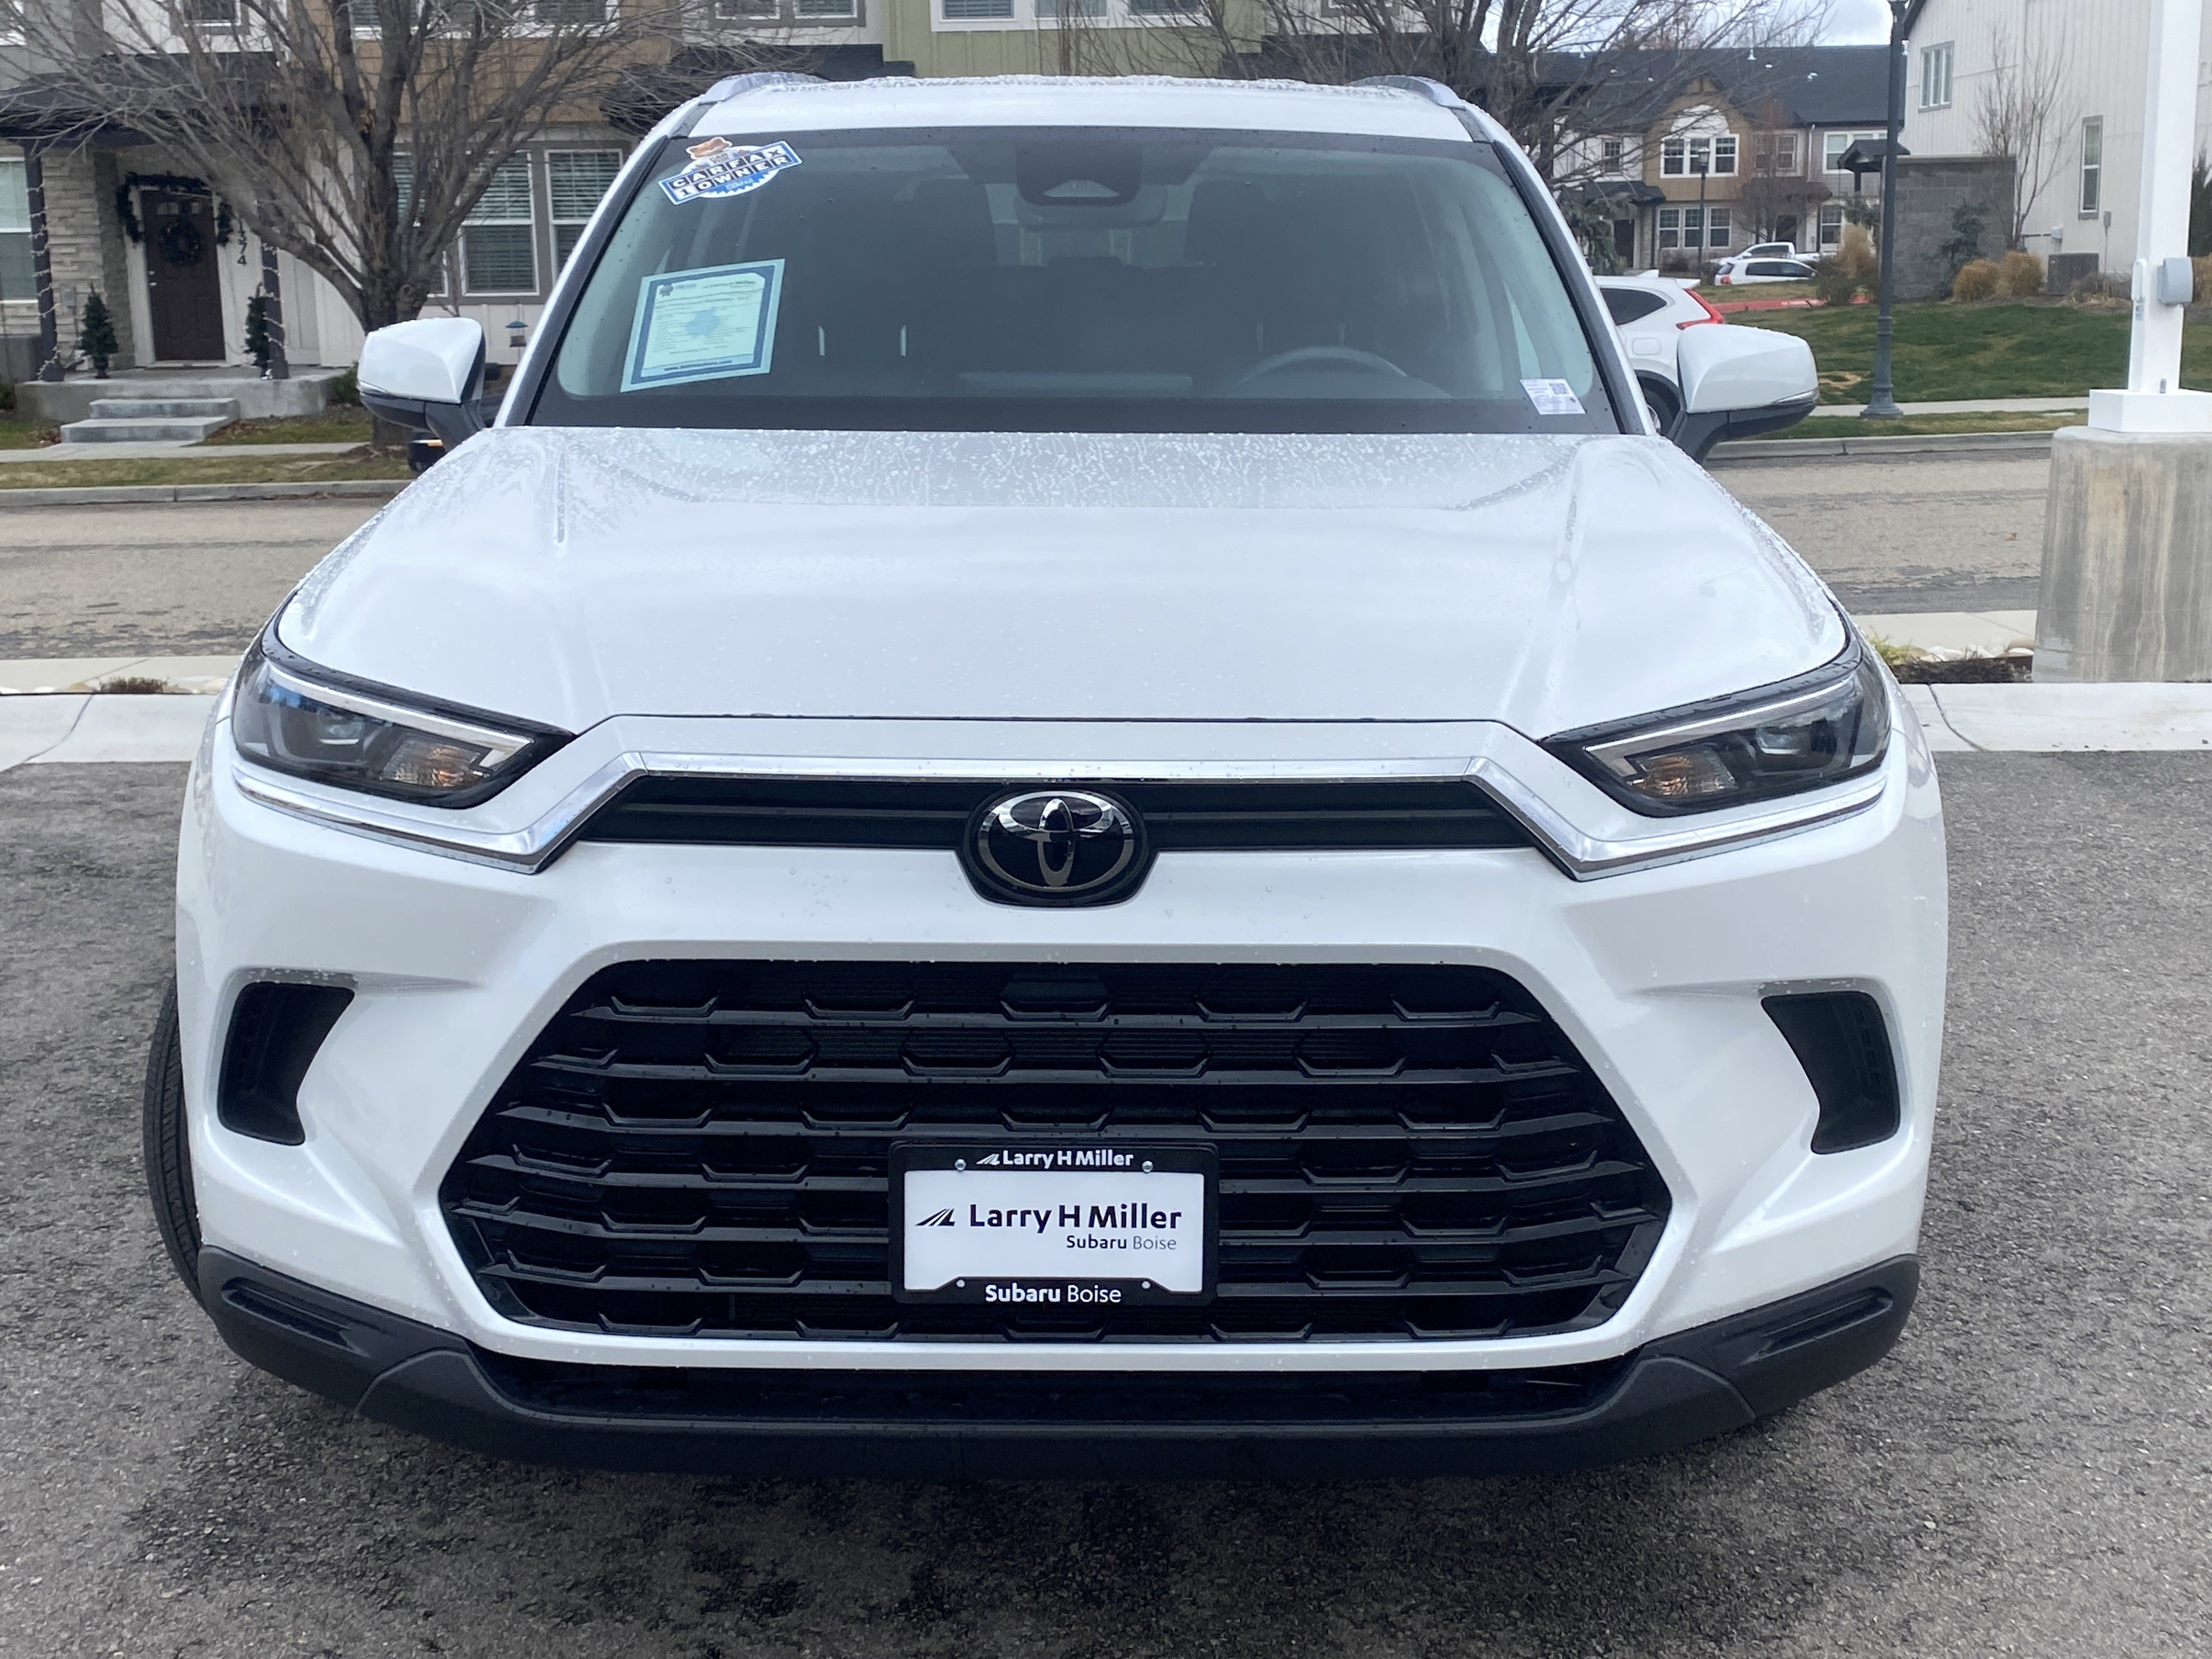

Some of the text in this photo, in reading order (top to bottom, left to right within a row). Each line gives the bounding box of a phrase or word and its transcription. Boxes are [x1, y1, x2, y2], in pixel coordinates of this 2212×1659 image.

[672, 149, 782, 188] CARFAX
[698, 156, 788, 191] OWNER
[1003, 1149, 1134, 1169] Larry H Miller
[970, 1203, 1182, 1233] Larry H Miller
[1066, 1234, 1177, 1250] Subaru Boise
[985, 1283, 1121, 1303] Subaru Boise
